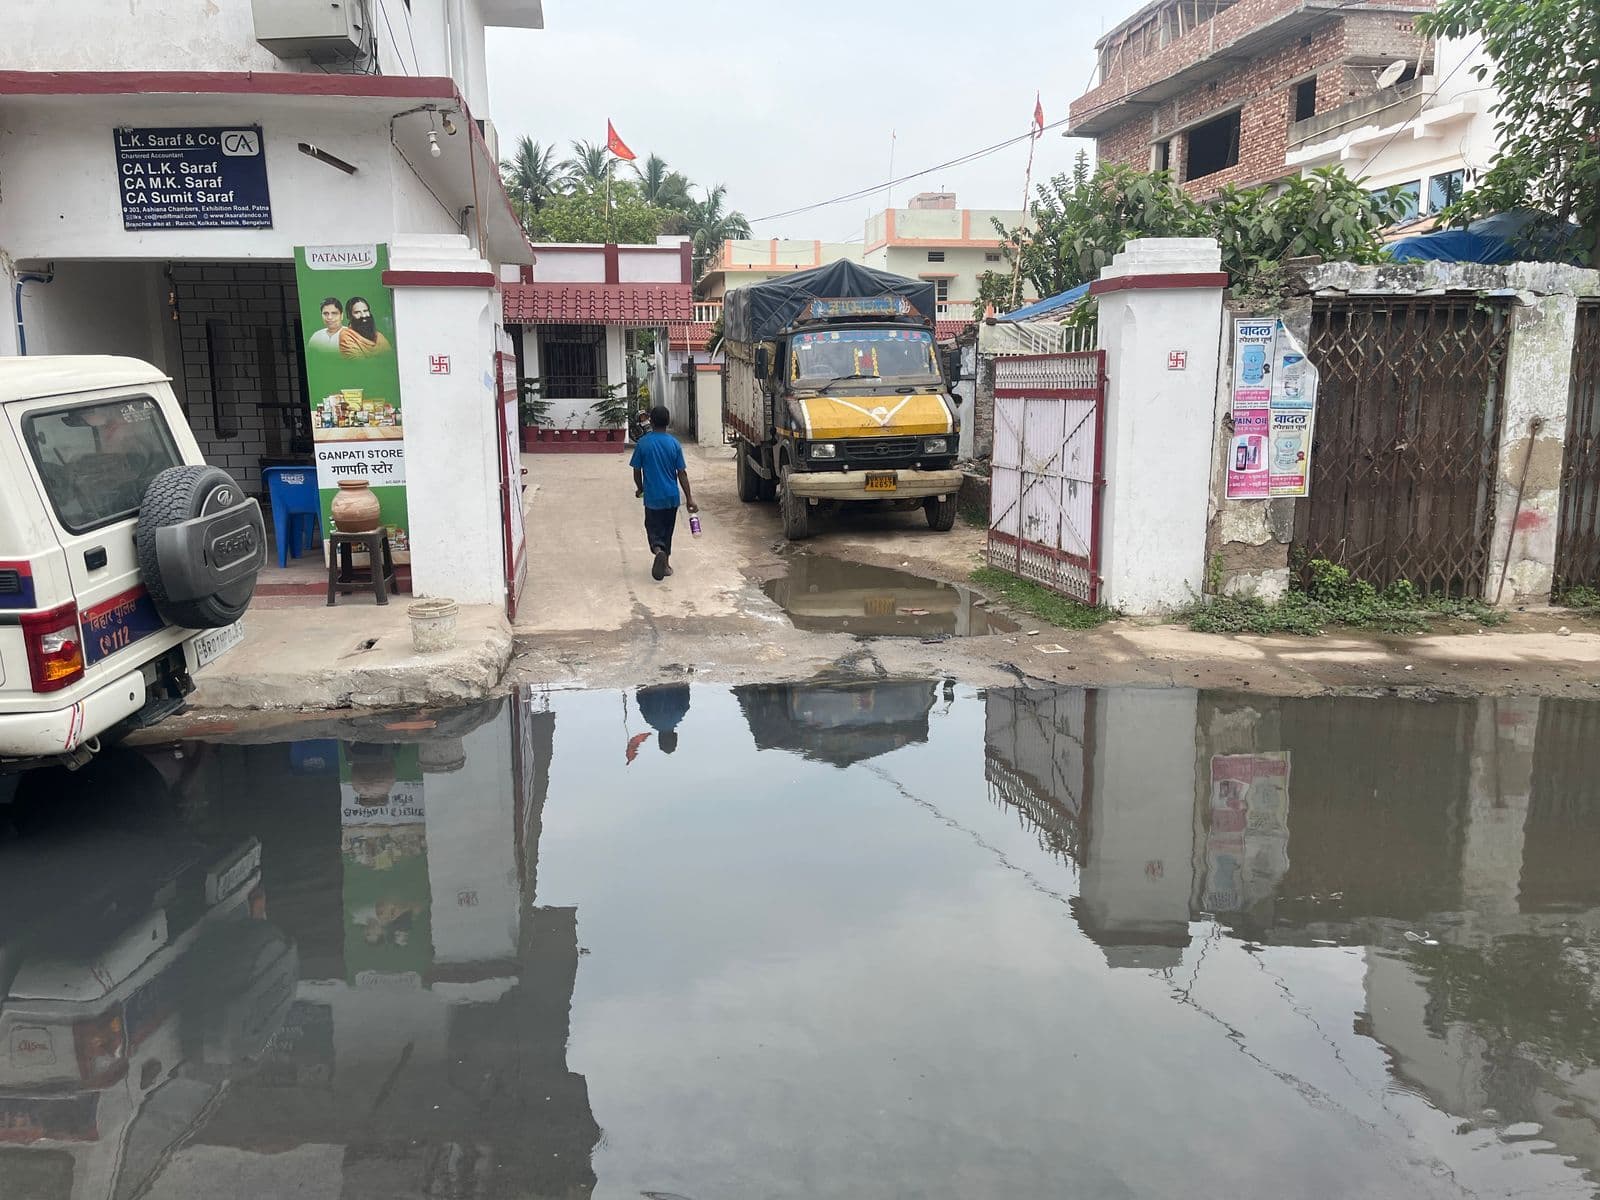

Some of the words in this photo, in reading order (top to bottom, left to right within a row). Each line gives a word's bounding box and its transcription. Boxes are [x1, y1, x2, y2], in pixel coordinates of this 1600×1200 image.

[120, 135, 145, 147] L.K.
[148, 134, 182, 146] Saraf
[185, 133, 195, 146] &
[198, 134, 220, 145] Co.
[122, 163, 145, 175] CA
[147, 162, 176, 174] L.K.
[180, 161, 218, 174] Saraf
[124, 177, 147, 190] CA
[149, 176, 181, 189] M.K.
[185, 176, 223, 189] Saraf
[126, 192, 149, 204] CA
[151, 191, 193, 204] Sumit
[196, 190, 235, 203] Saraf
[312, 252, 369, 262] PATANJALI
[318, 450, 365, 461] GANPATI
[367, 448, 404, 459] STORE
[331, 462, 368, 476] गणपति
[371, 460, 394, 474] स्टोर
[89, 611, 114, 632] बिहार
[114, 598, 137, 625] पुलिस
[111, 625, 130, 650] 112
